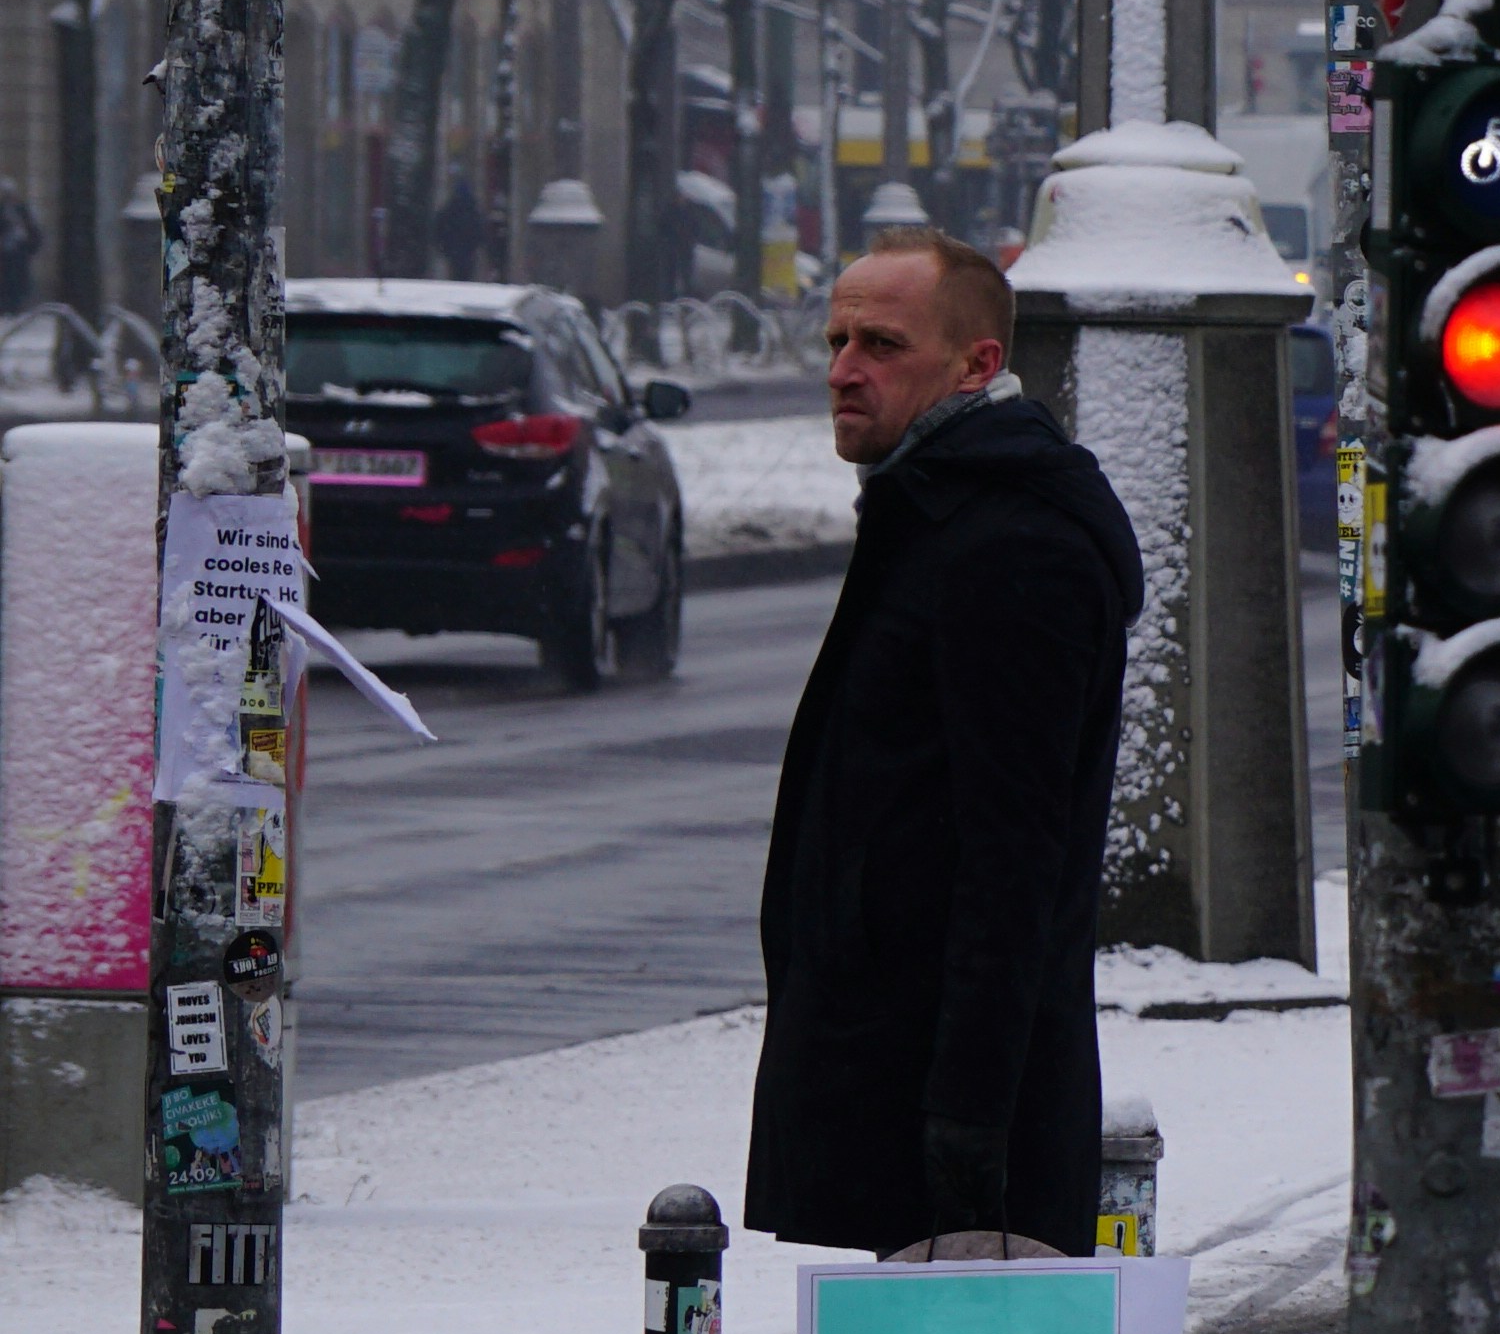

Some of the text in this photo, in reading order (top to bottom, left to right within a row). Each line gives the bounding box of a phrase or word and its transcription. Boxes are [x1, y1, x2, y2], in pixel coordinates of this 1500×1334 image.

[217, 528, 289, 549] Wir sind
[204, 557, 270, 574] cooles
[194, 608, 246, 626] aber
[178, 995, 210, 1007] MOVES
[181, 1033, 211, 1046] LOVES
